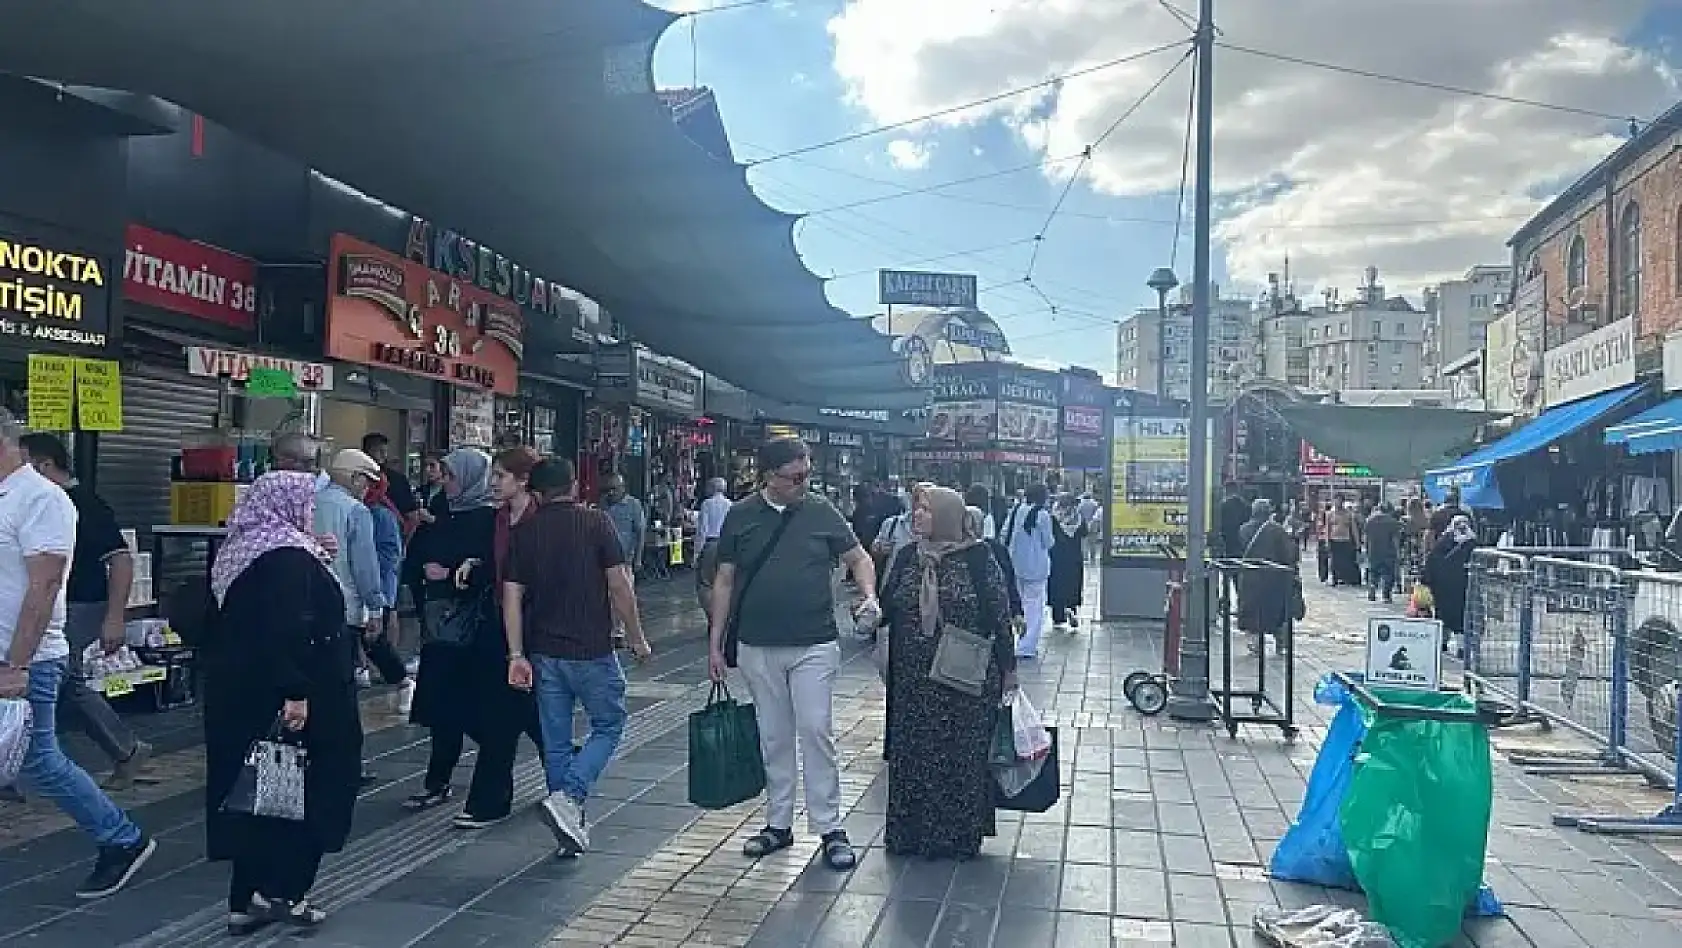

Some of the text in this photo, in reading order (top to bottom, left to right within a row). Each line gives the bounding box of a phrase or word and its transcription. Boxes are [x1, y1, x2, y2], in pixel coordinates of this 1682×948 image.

[0, 241, 103, 286] NOKTA
[406, 215, 562, 318] AKSESUAR
[230, 281, 255, 312] 38
[434, 324, 460, 357] 38
